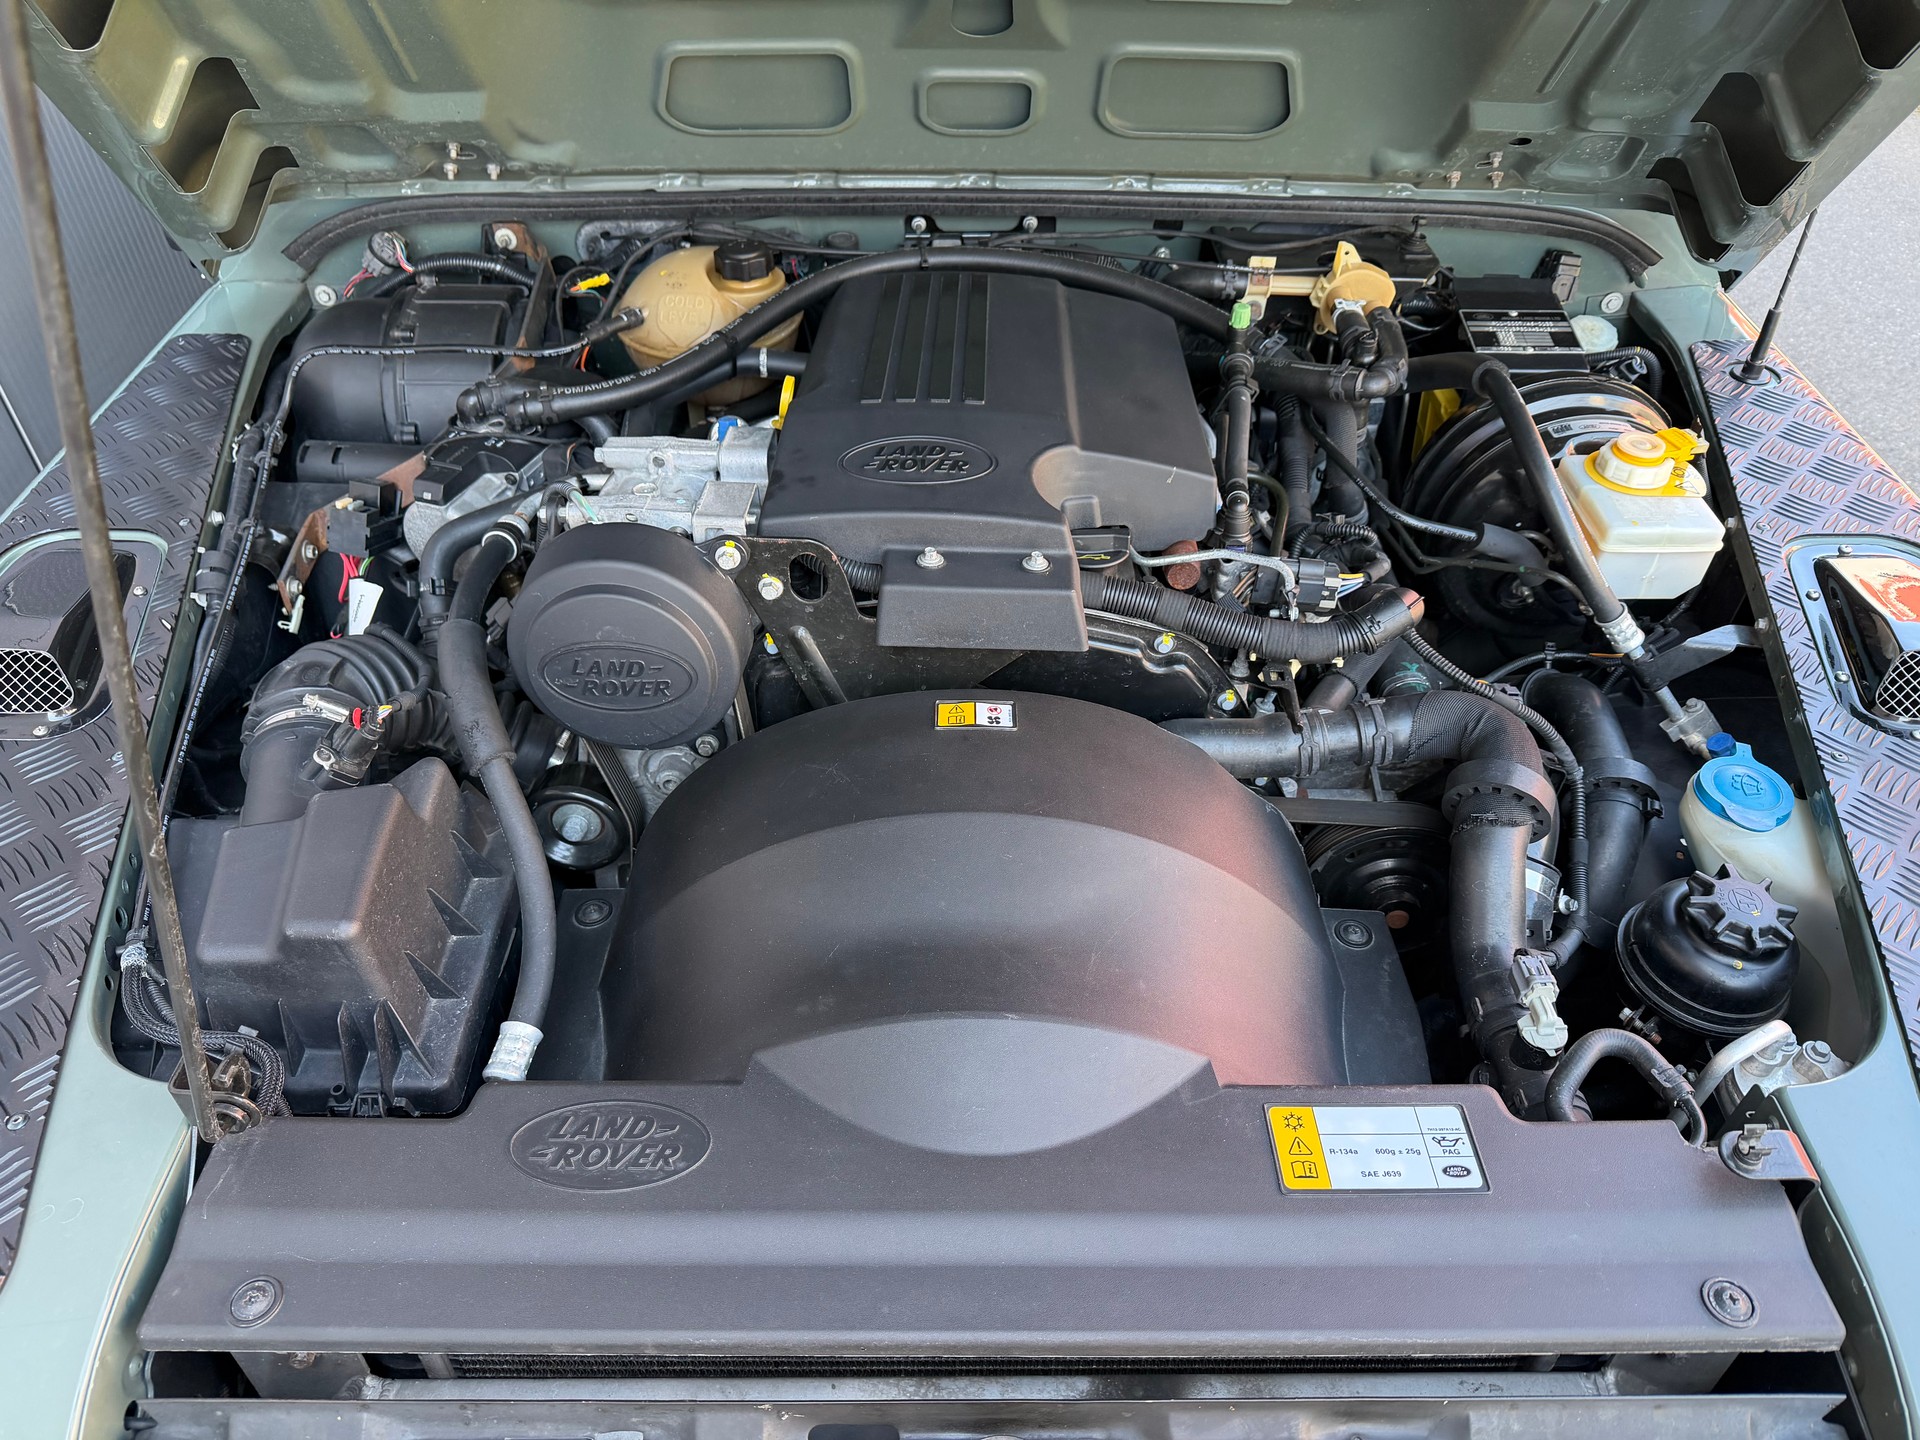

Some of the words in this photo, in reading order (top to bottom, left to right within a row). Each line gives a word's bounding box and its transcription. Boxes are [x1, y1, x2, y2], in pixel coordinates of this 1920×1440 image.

[665, 295, 705, 309] COLD
[874, 445, 946, 459] LAND
[880, 458, 970, 474] ROVER
[571, 658, 646, 677] LAND
[583, 679, 672, 697] ROVER
[549, 1115, 657, 1142] LAND
[550, 1143, 683, 1171] ROVER
[1375, 1148, 1396, 1156] 600g
[1405, 1148, 1422, 1156] 25g
[1360, 1170, 1380, 1178] SAE
[1382, 1170, 1402, 1178] J639
